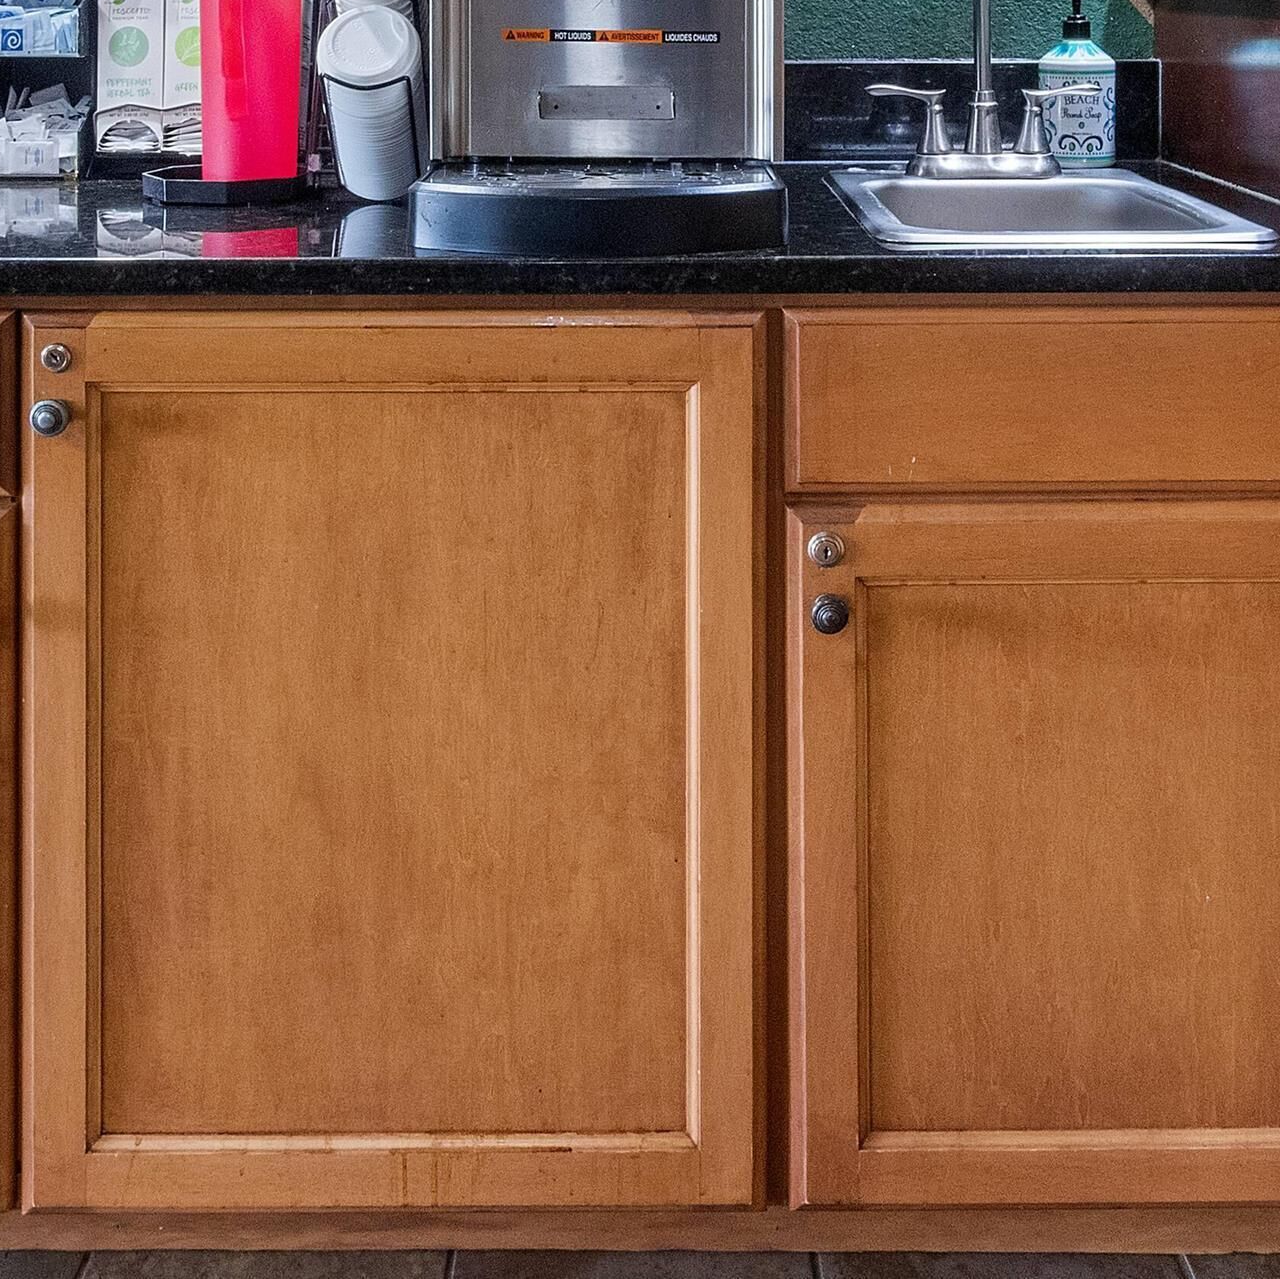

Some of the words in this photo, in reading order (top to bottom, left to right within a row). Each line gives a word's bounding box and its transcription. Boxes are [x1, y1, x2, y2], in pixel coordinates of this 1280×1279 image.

[516, 31, 545, 39] WARNING
[554, 32, 567, 40] HOT
[568, 32, 592, 40] LIQUIDS
[611, 33, 659, 41] AVERTISSEMENT
[664, 33, 692, 41] LIQUIDES
[693, 33, 718, 42] CHAUDS
[1063, 95, 1100, 106] BEACH
[1084, 106, 1102, 122] Soap
